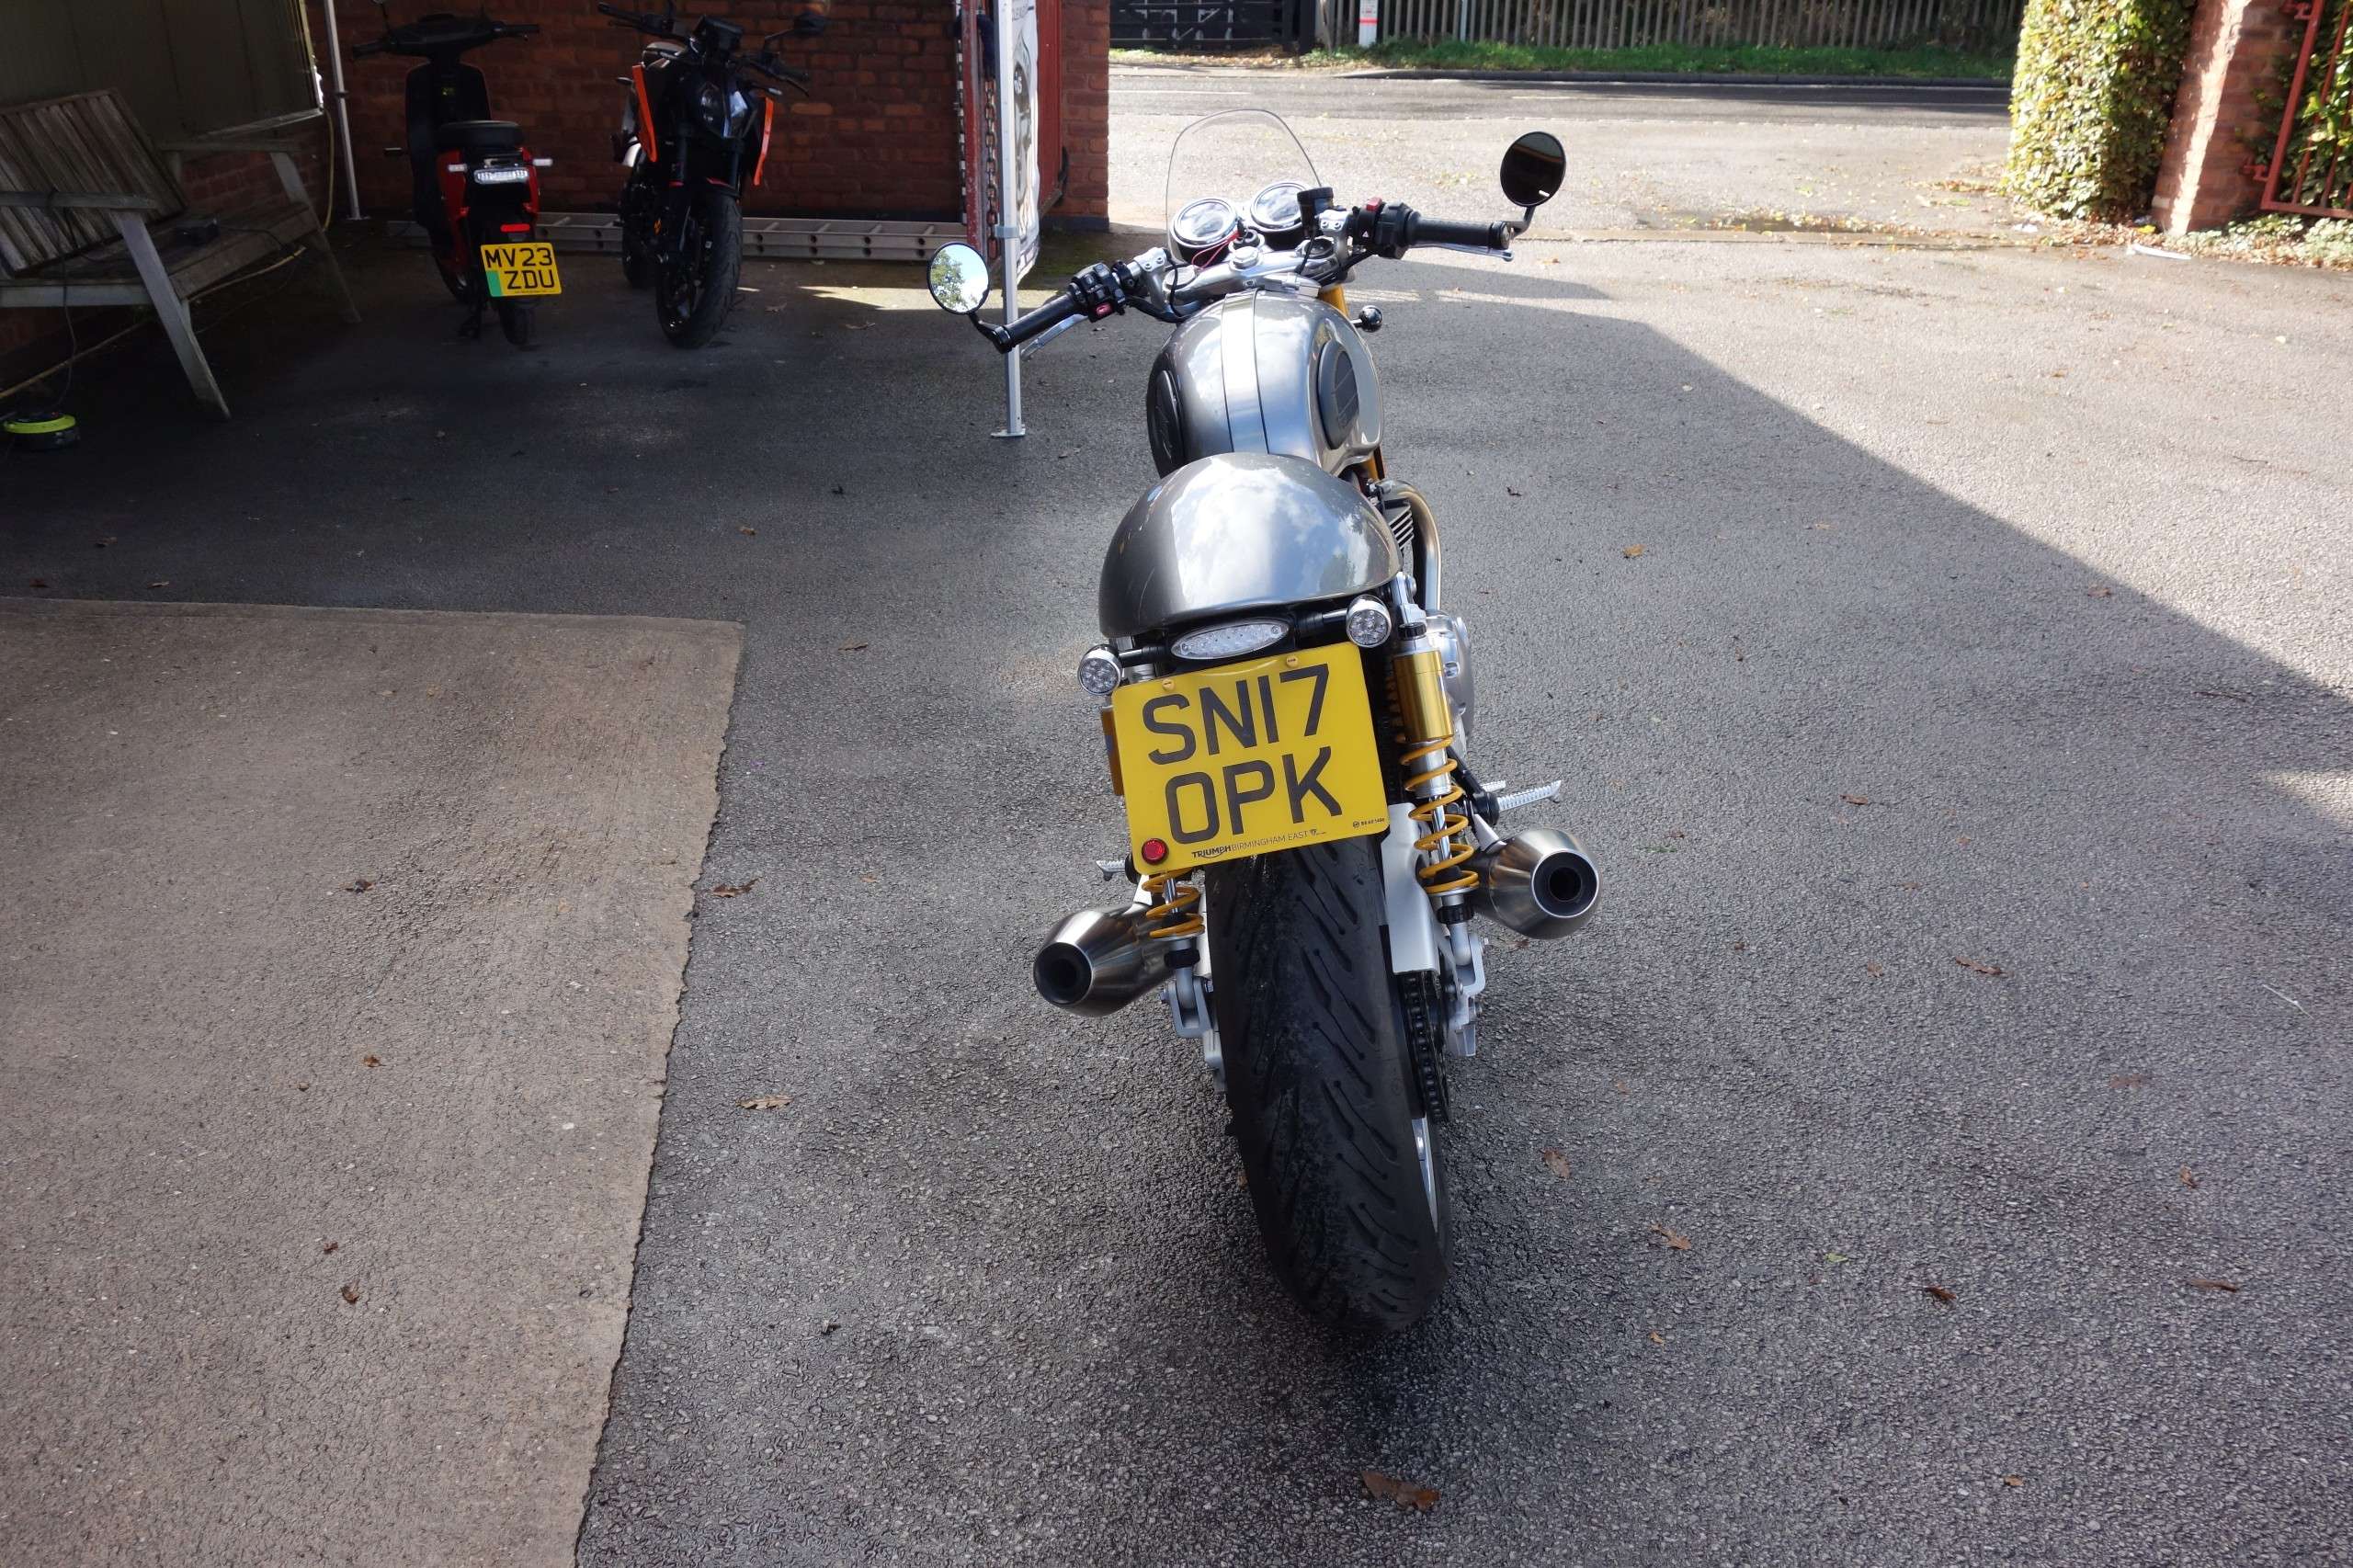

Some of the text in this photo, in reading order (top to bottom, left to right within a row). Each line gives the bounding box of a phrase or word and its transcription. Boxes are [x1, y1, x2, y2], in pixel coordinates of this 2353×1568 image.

[484, 247, 552, 267] MV23
[504, 269, 555, 290] ZDU
[1142, 663, 1329, 765] SN17
[1165, 745, 1342, 845] OPK
[1191, 830, 1308, 858] TRIUMPH BIRMINGHAM EAST
